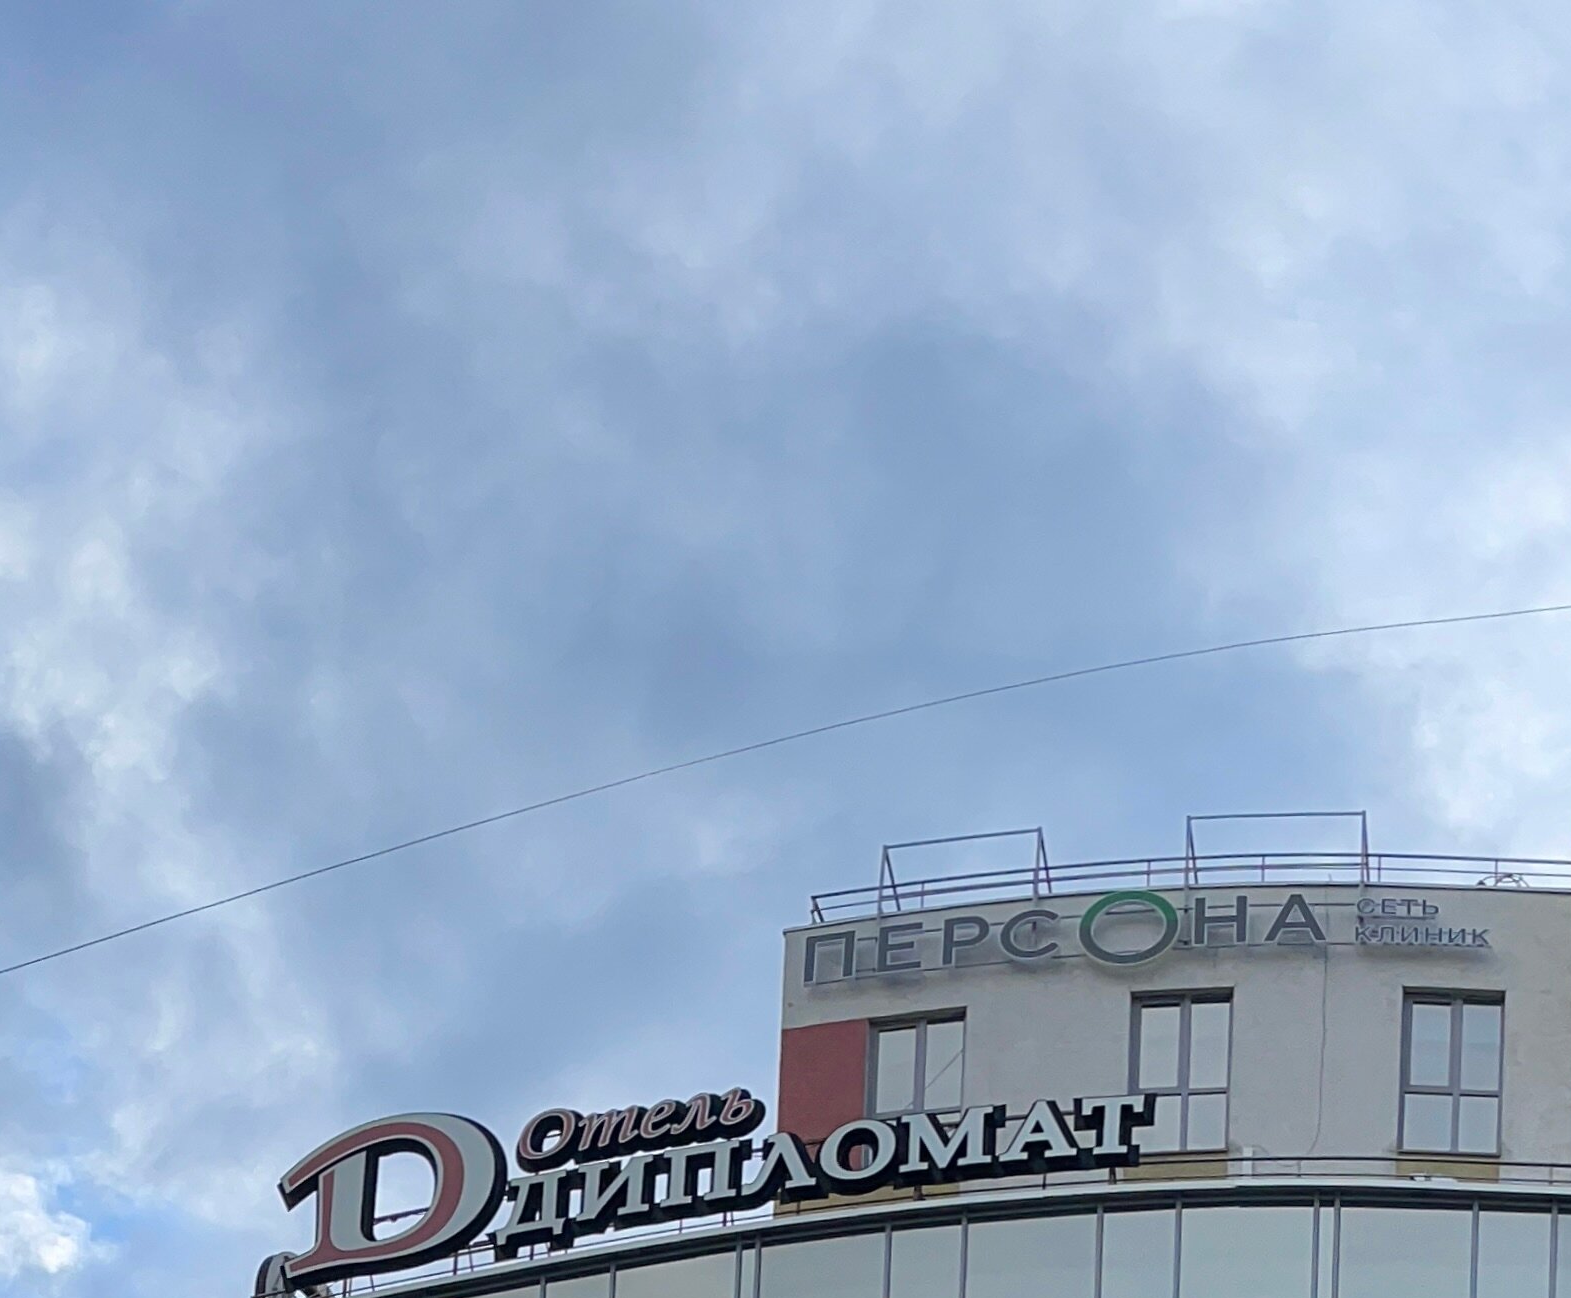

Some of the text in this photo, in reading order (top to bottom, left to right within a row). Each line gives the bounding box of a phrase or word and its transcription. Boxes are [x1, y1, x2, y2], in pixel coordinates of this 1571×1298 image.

[803, 891, 1327, 983] ПЕРСОНА
[1354, 925, 1490, 947] КЛИНИК
[1357, 897, 1440, 917] СЕТЬ
[516, 1087, 763, 1168] Отель
[495, 1094, 1156, 1255] ДИПЛОМАТ
